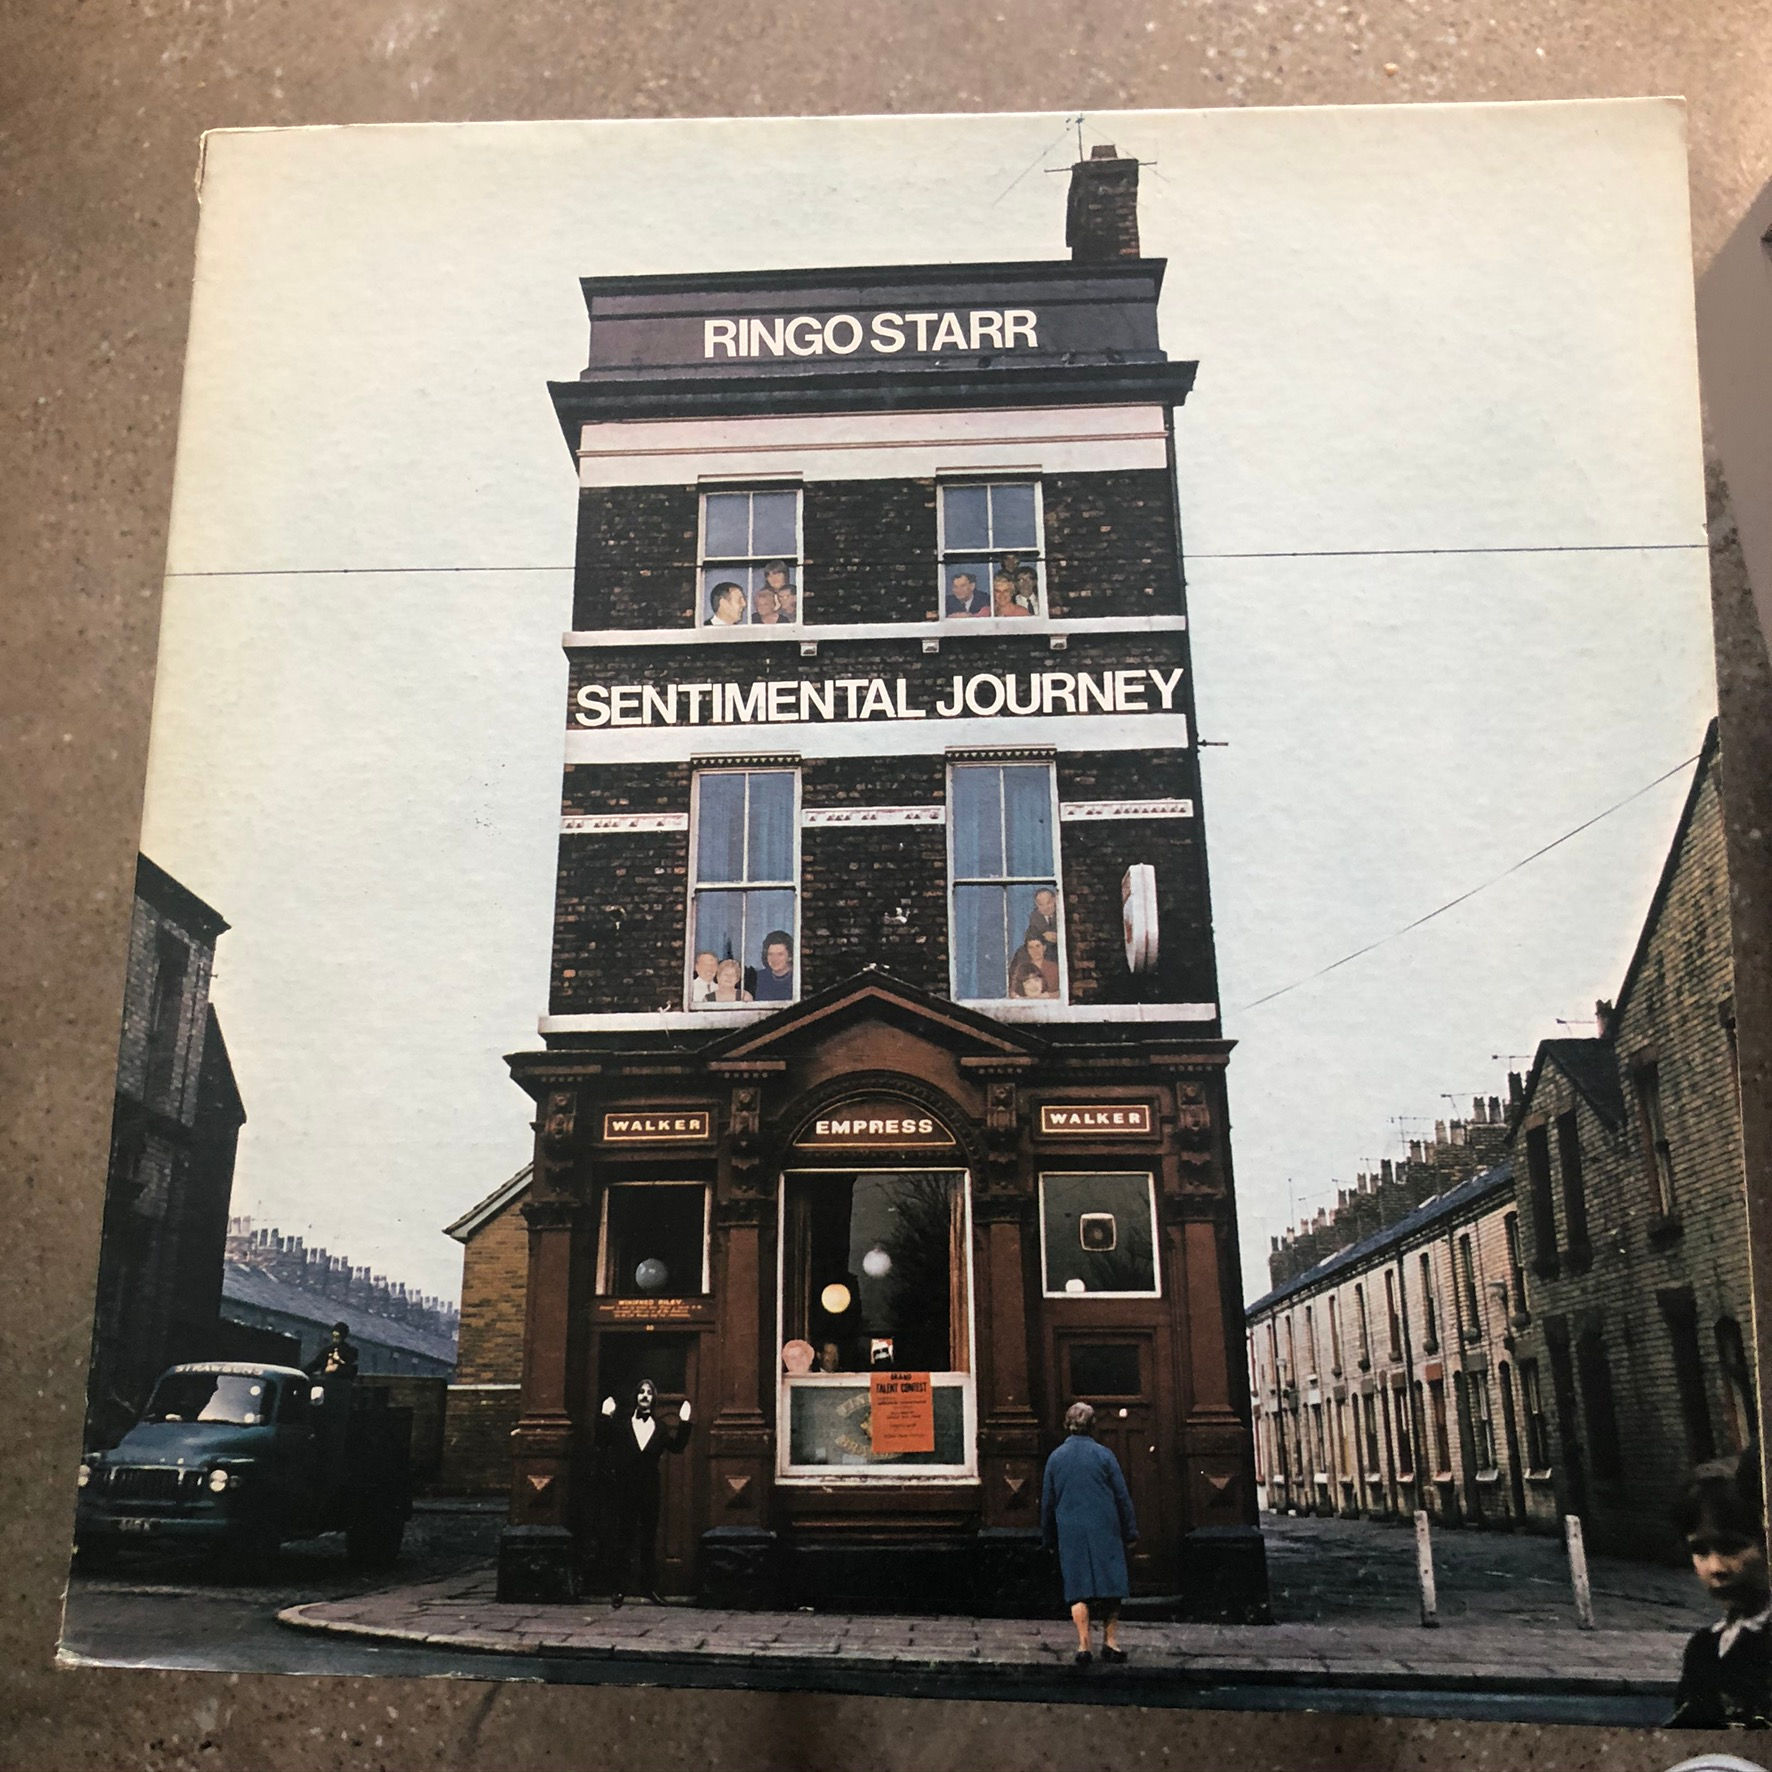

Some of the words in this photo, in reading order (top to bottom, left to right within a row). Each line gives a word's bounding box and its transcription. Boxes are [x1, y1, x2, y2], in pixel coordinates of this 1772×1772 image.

[703, 313, 864, 359] RINGO
[869, 309, 1039, 354] STARR
[575, 678, 927, 727] SENTIMENTAL
[935, 667, 1184, 718] JOURNEY
[612, 1119, 701, 1132] WALKER
[1049, 1112, 1141, 1125] WALKER
[815, 1119, 933, 1135] EMPRESS
[876, 1383, 898, 1394] TALENT
[900, 1382, 927, 1393] CONTEST
